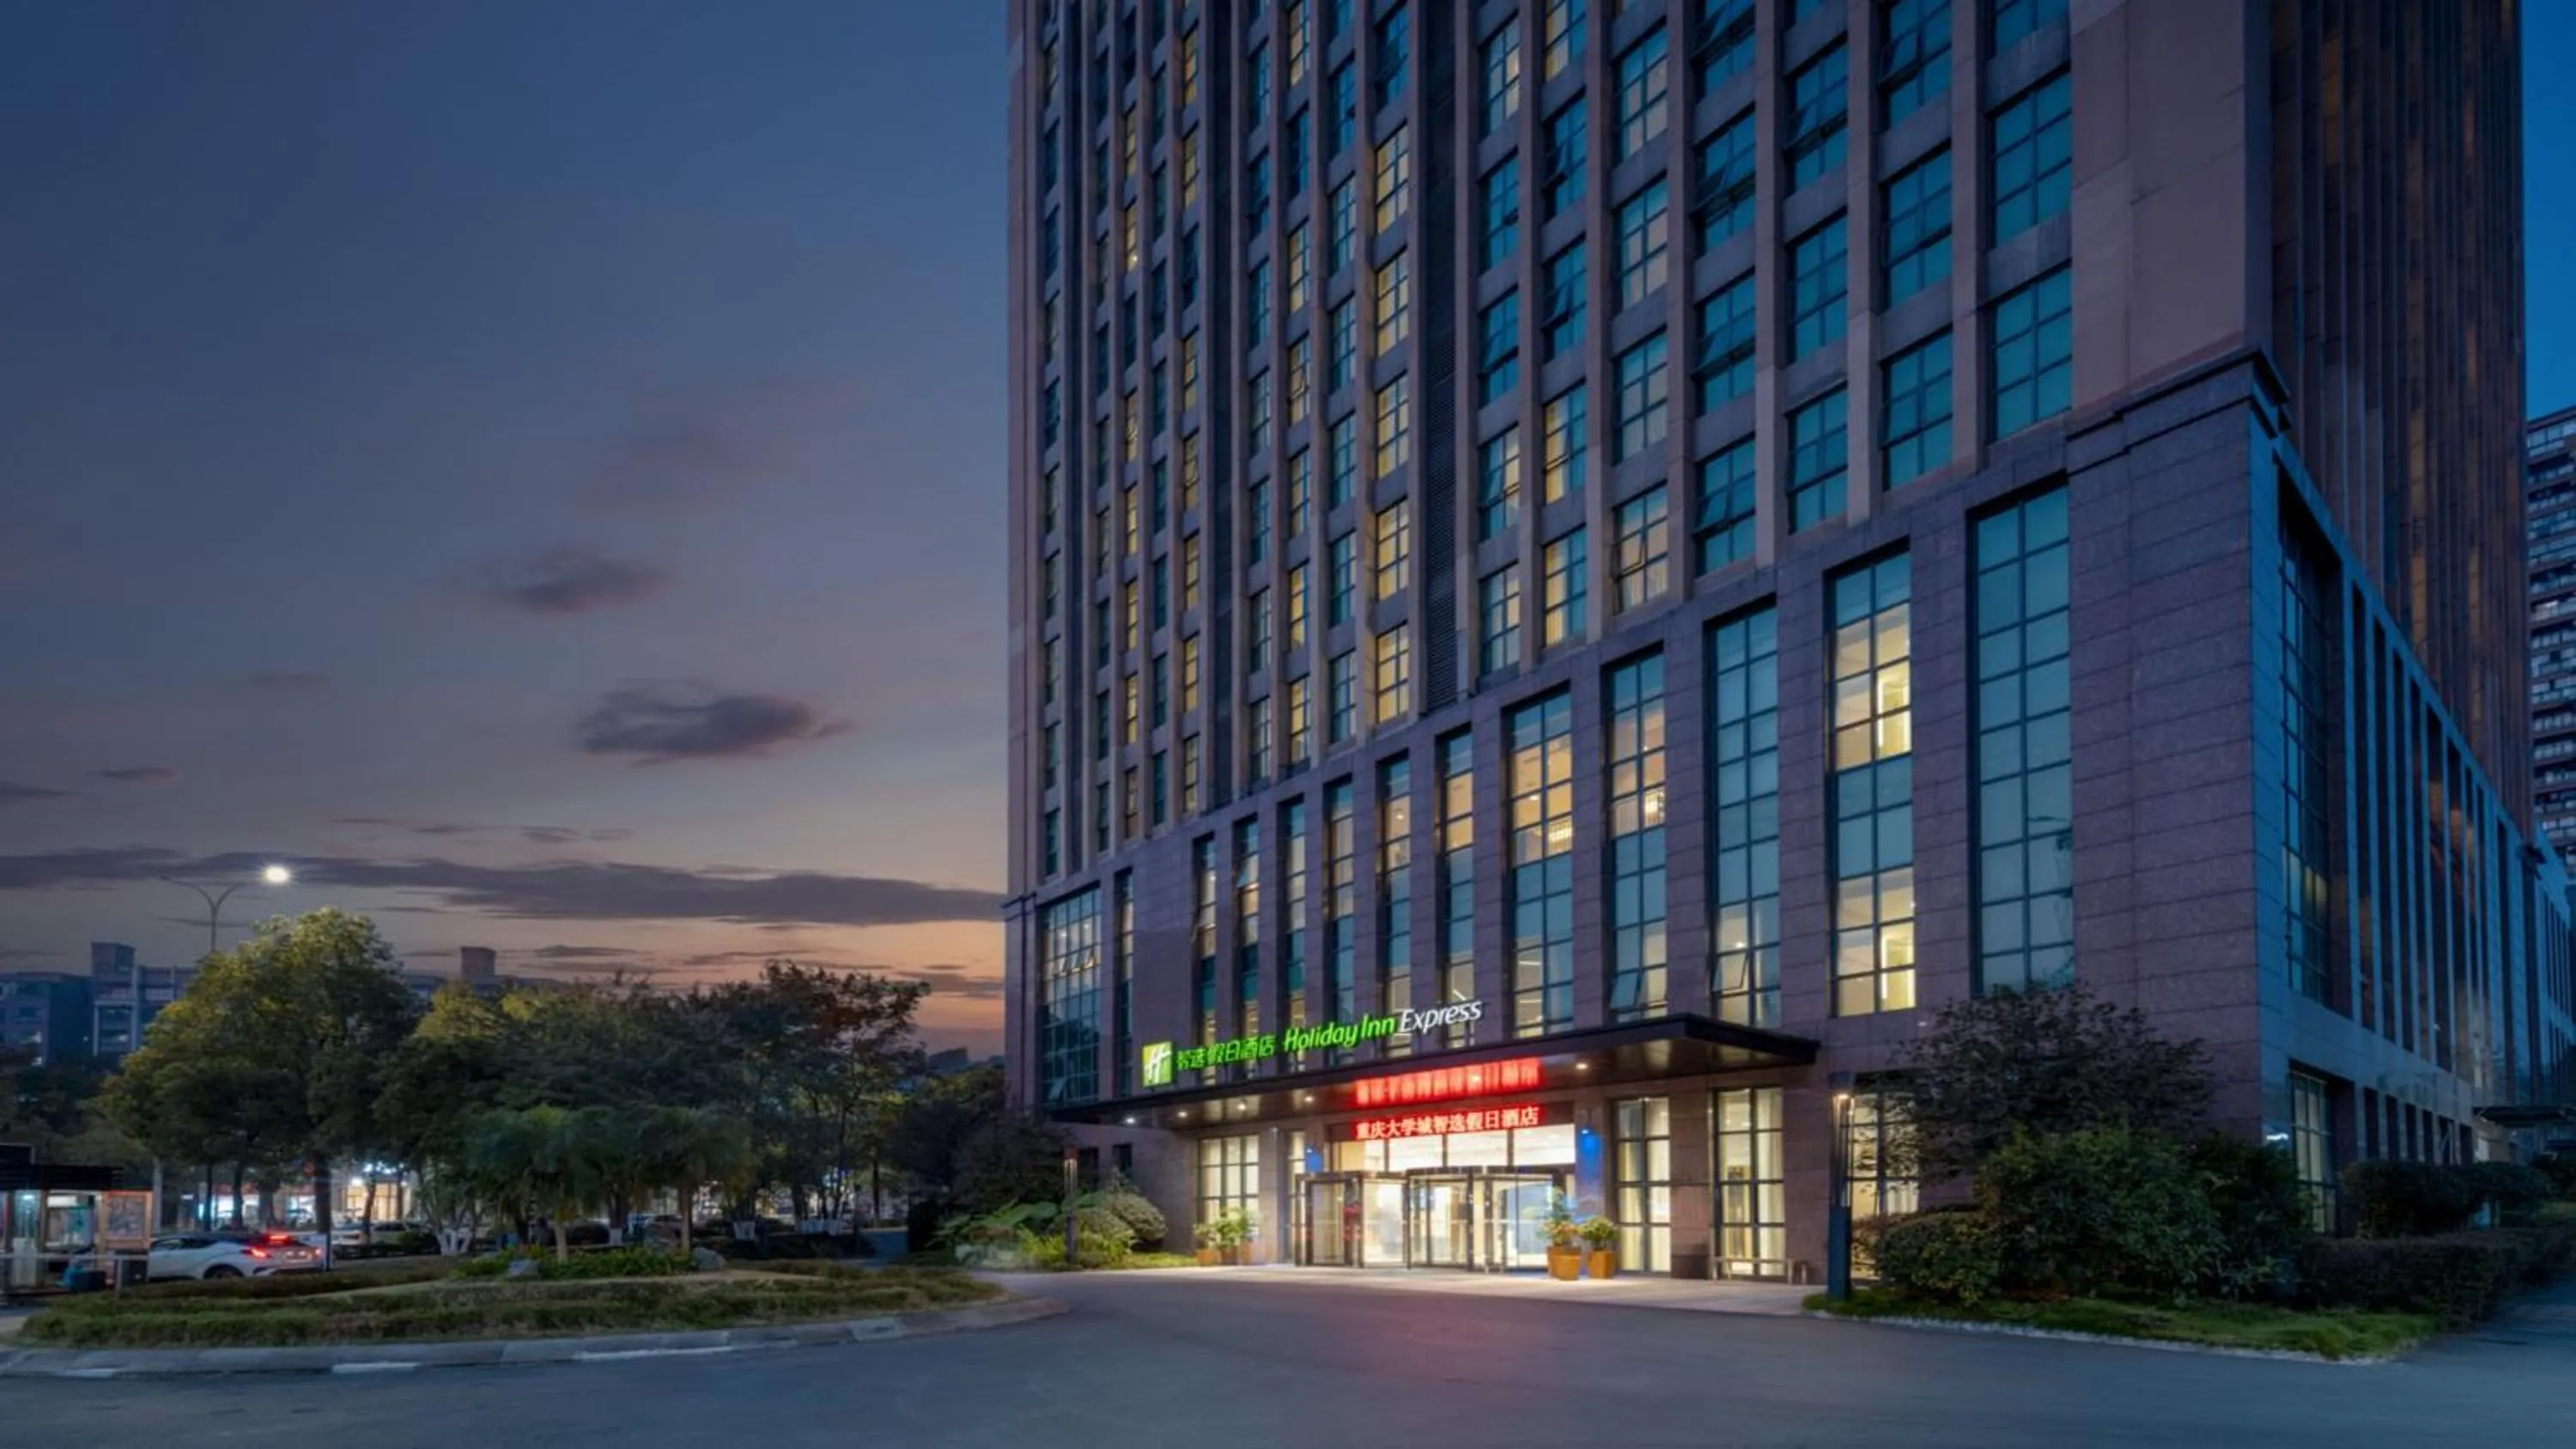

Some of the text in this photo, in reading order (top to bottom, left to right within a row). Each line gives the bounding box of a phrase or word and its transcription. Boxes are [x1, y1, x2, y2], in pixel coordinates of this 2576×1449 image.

[1285, 1001, 1481, 1051] Holiday Inn Express
[1177, 1034, 1275, 1070] 智选假日酒店
[1356, 1106, 1540, 1140] 重庆大学城智选假日酒店
